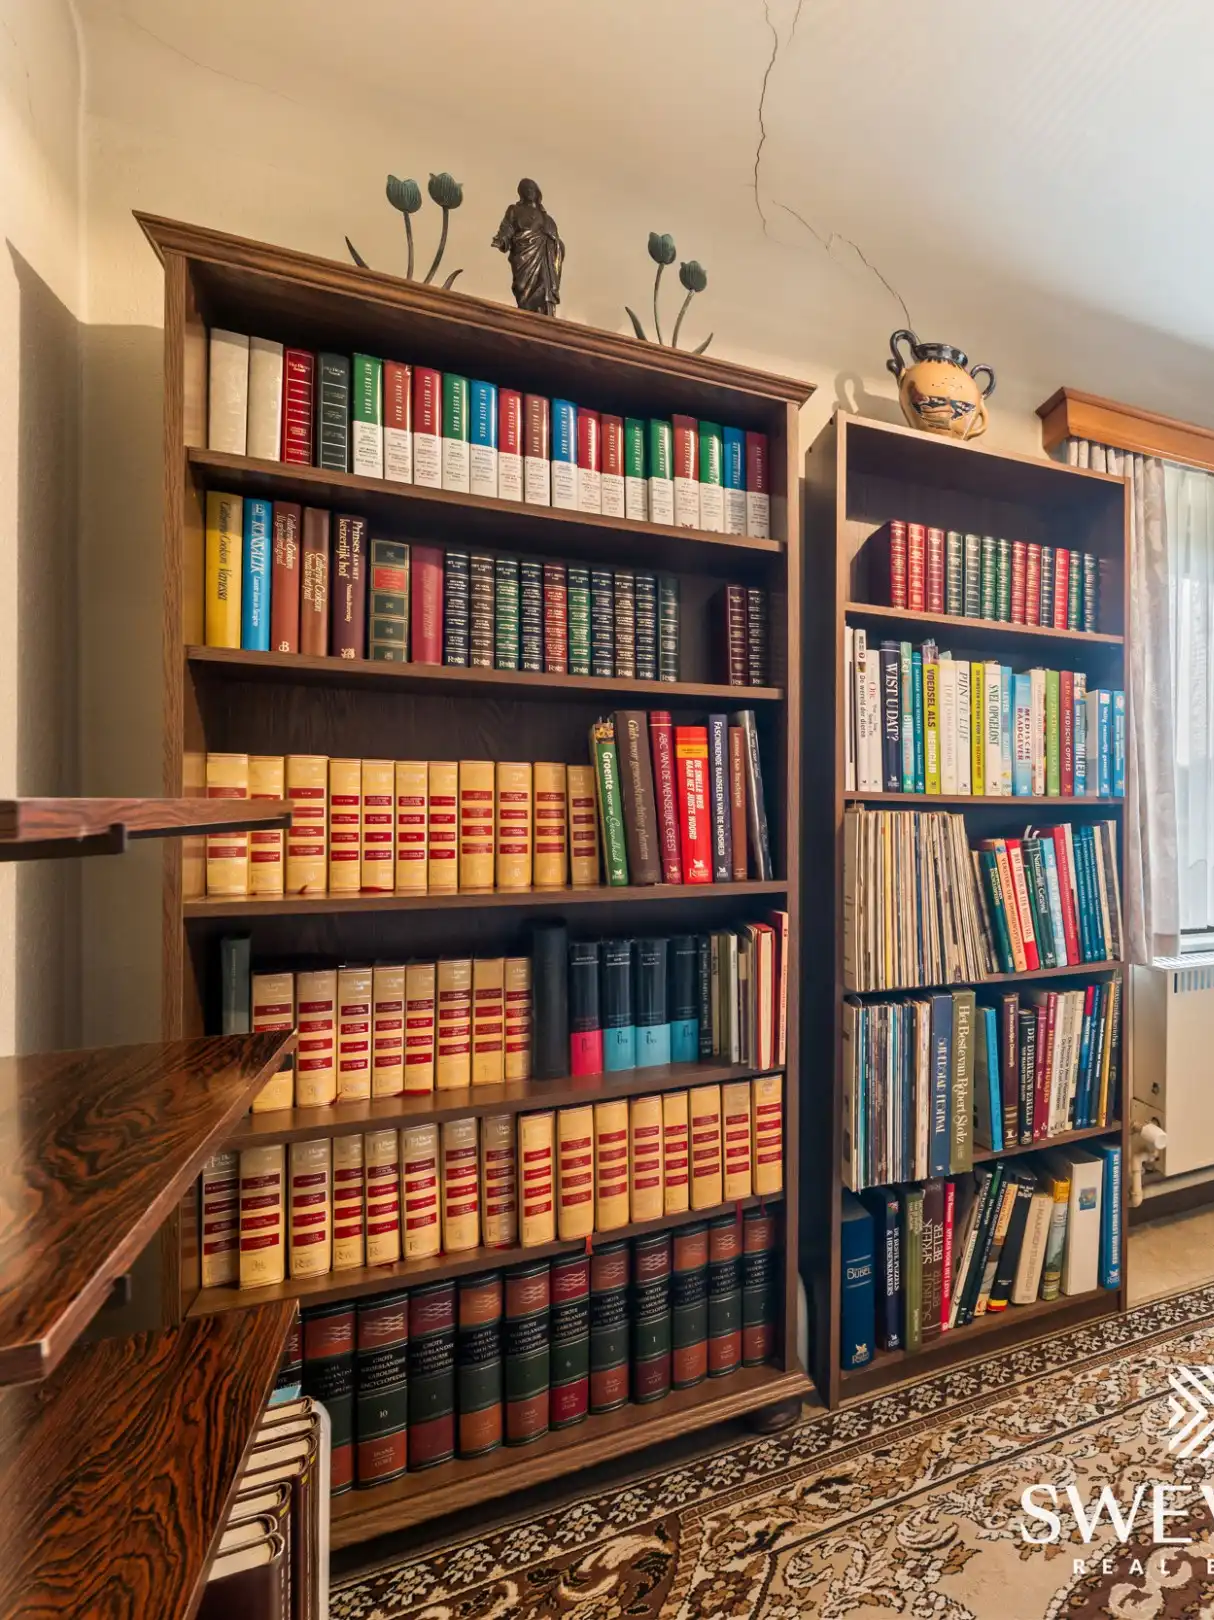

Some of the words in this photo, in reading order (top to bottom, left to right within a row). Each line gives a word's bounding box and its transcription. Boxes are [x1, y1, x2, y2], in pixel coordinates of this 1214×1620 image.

[352, 521, 364, 552] Prinses
[314, 552, 326, 584] Catherine
[352, 554, 360, 566] AAN
[314, 584, 325, 612] Cookson
[860, 675, 866, 683] De
[886, 662, 898, 694] WIST
[926, 669, 934, 708] VOEDSEL
[959, 671, 968, 699] PIJN
[886, 697, 898, 708] U
[989, 684, 999, 704] SNEL
[960, 700, 968, 715] TE
[886, 710, 899, 741] DAT?
[959, 718, 968, 743] LIJF
[989, 706, 999, 746] OPGELOST
[658, 732, 669, 750] ABC
[714, 721, 723, 766] FASCINERENDE
[602, 752, 613, 790] Groente
[660, 752, 670, 768] VAN
[686, 760, 694, 777] NAAR
[695, 760, 703, 769] DE
[1076, 744, 1085, 776] MILIEU
[662, 770, 670, 779] DE
[687, 778, 695, 790] HET
[715, 767, 723, 801] RAADSELEN
[663, 782, 674, 825] MENSELIJKE
[687, 792, 695, 814] JUISTE
[696, 794, 704, 809] WEG
[716, 802, 724, 814] VAN
[606, 814, 622, 862] Gezondheid
[666, 828, 676, 852] GEEST
[688, 816, 696, 840] WOORD
[717, 825, 725, 856] MENSHEID
[1038, 888, 1048, 913] Gezond
[958, 1005, 970, 1023] Het
[957, 1024, 970, 1056] Beste
[1027, 1028, 1034, 1042] DE
[957, 1056, 966, 1076] van
[952, 1078, 968, 1113] Robert
[1026, 1044, 1034, 1126] DIERENWERELD
[953, 1115, 968, 1144] Stolz
[923, 1218, 932, 1264] SPREEK
[933, 1222, 943, 1262] BETER
